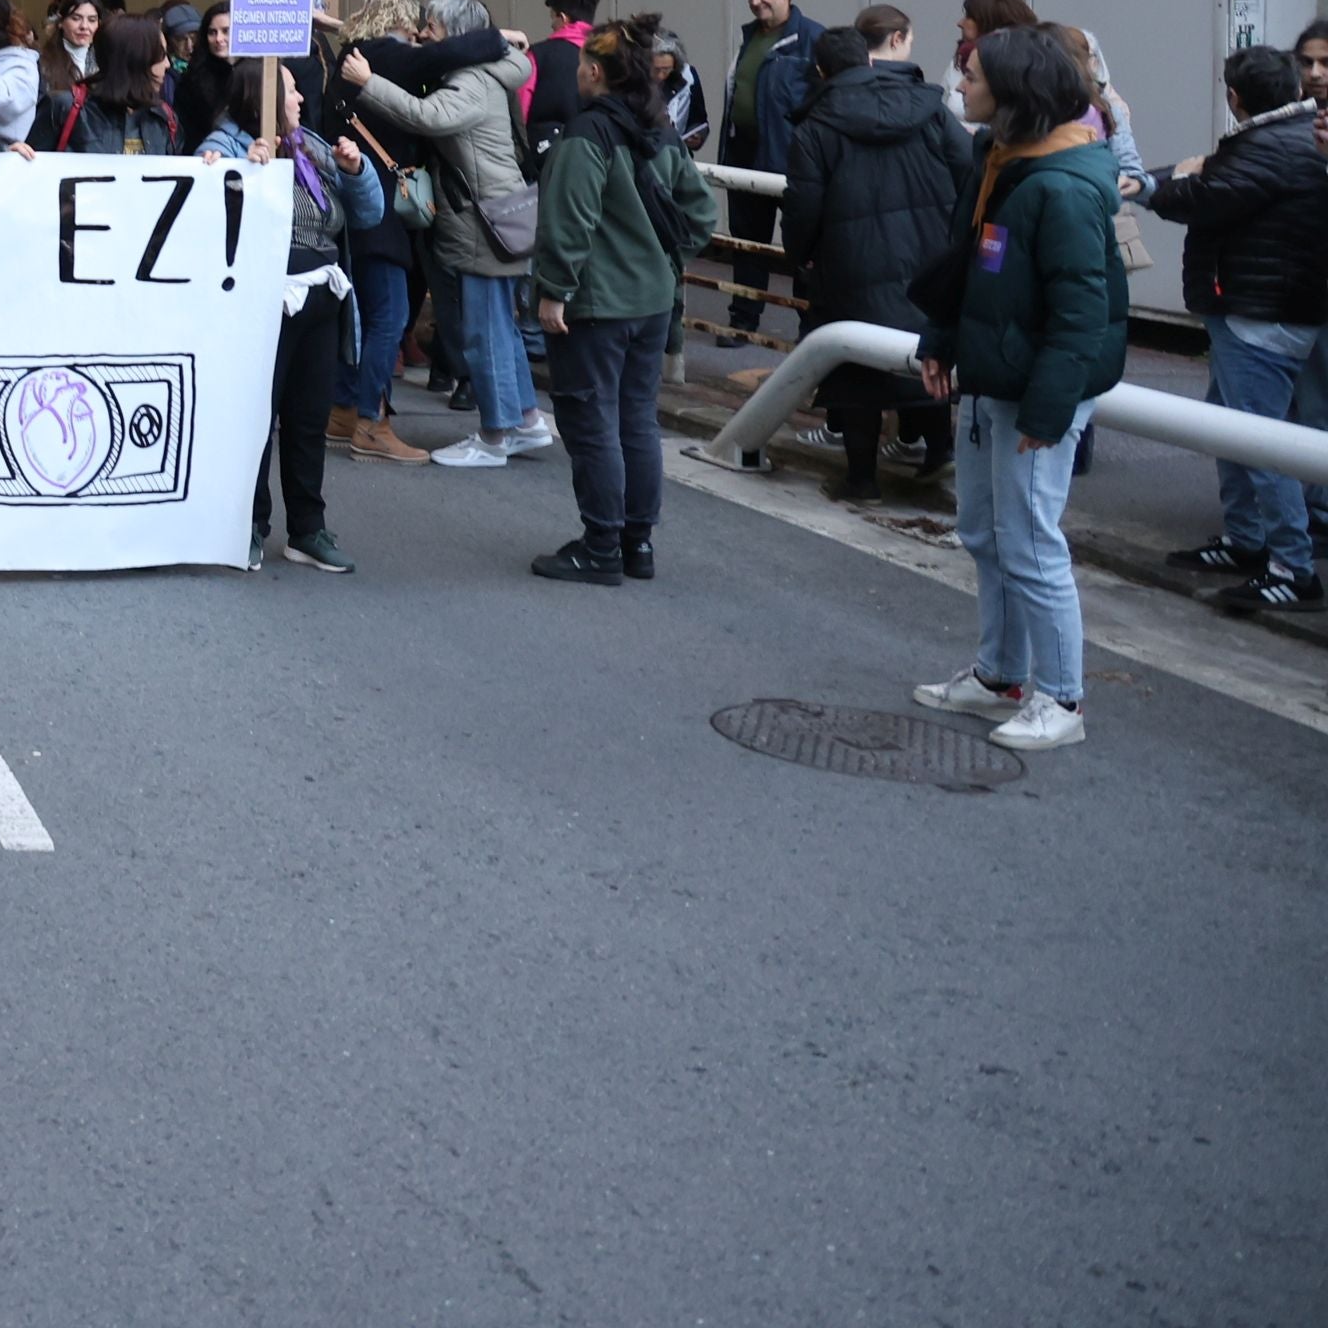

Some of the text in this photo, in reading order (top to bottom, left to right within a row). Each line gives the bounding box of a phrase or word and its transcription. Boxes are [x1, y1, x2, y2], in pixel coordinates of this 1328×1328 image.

[267, 10, 296, 24] INTERNO
[297, 10, 310, 24] DEL
[238, 29, 268, 43] EMPLEO
[270, 30, 278, 43] DE
[58, 170, 244, 292] EZ!
